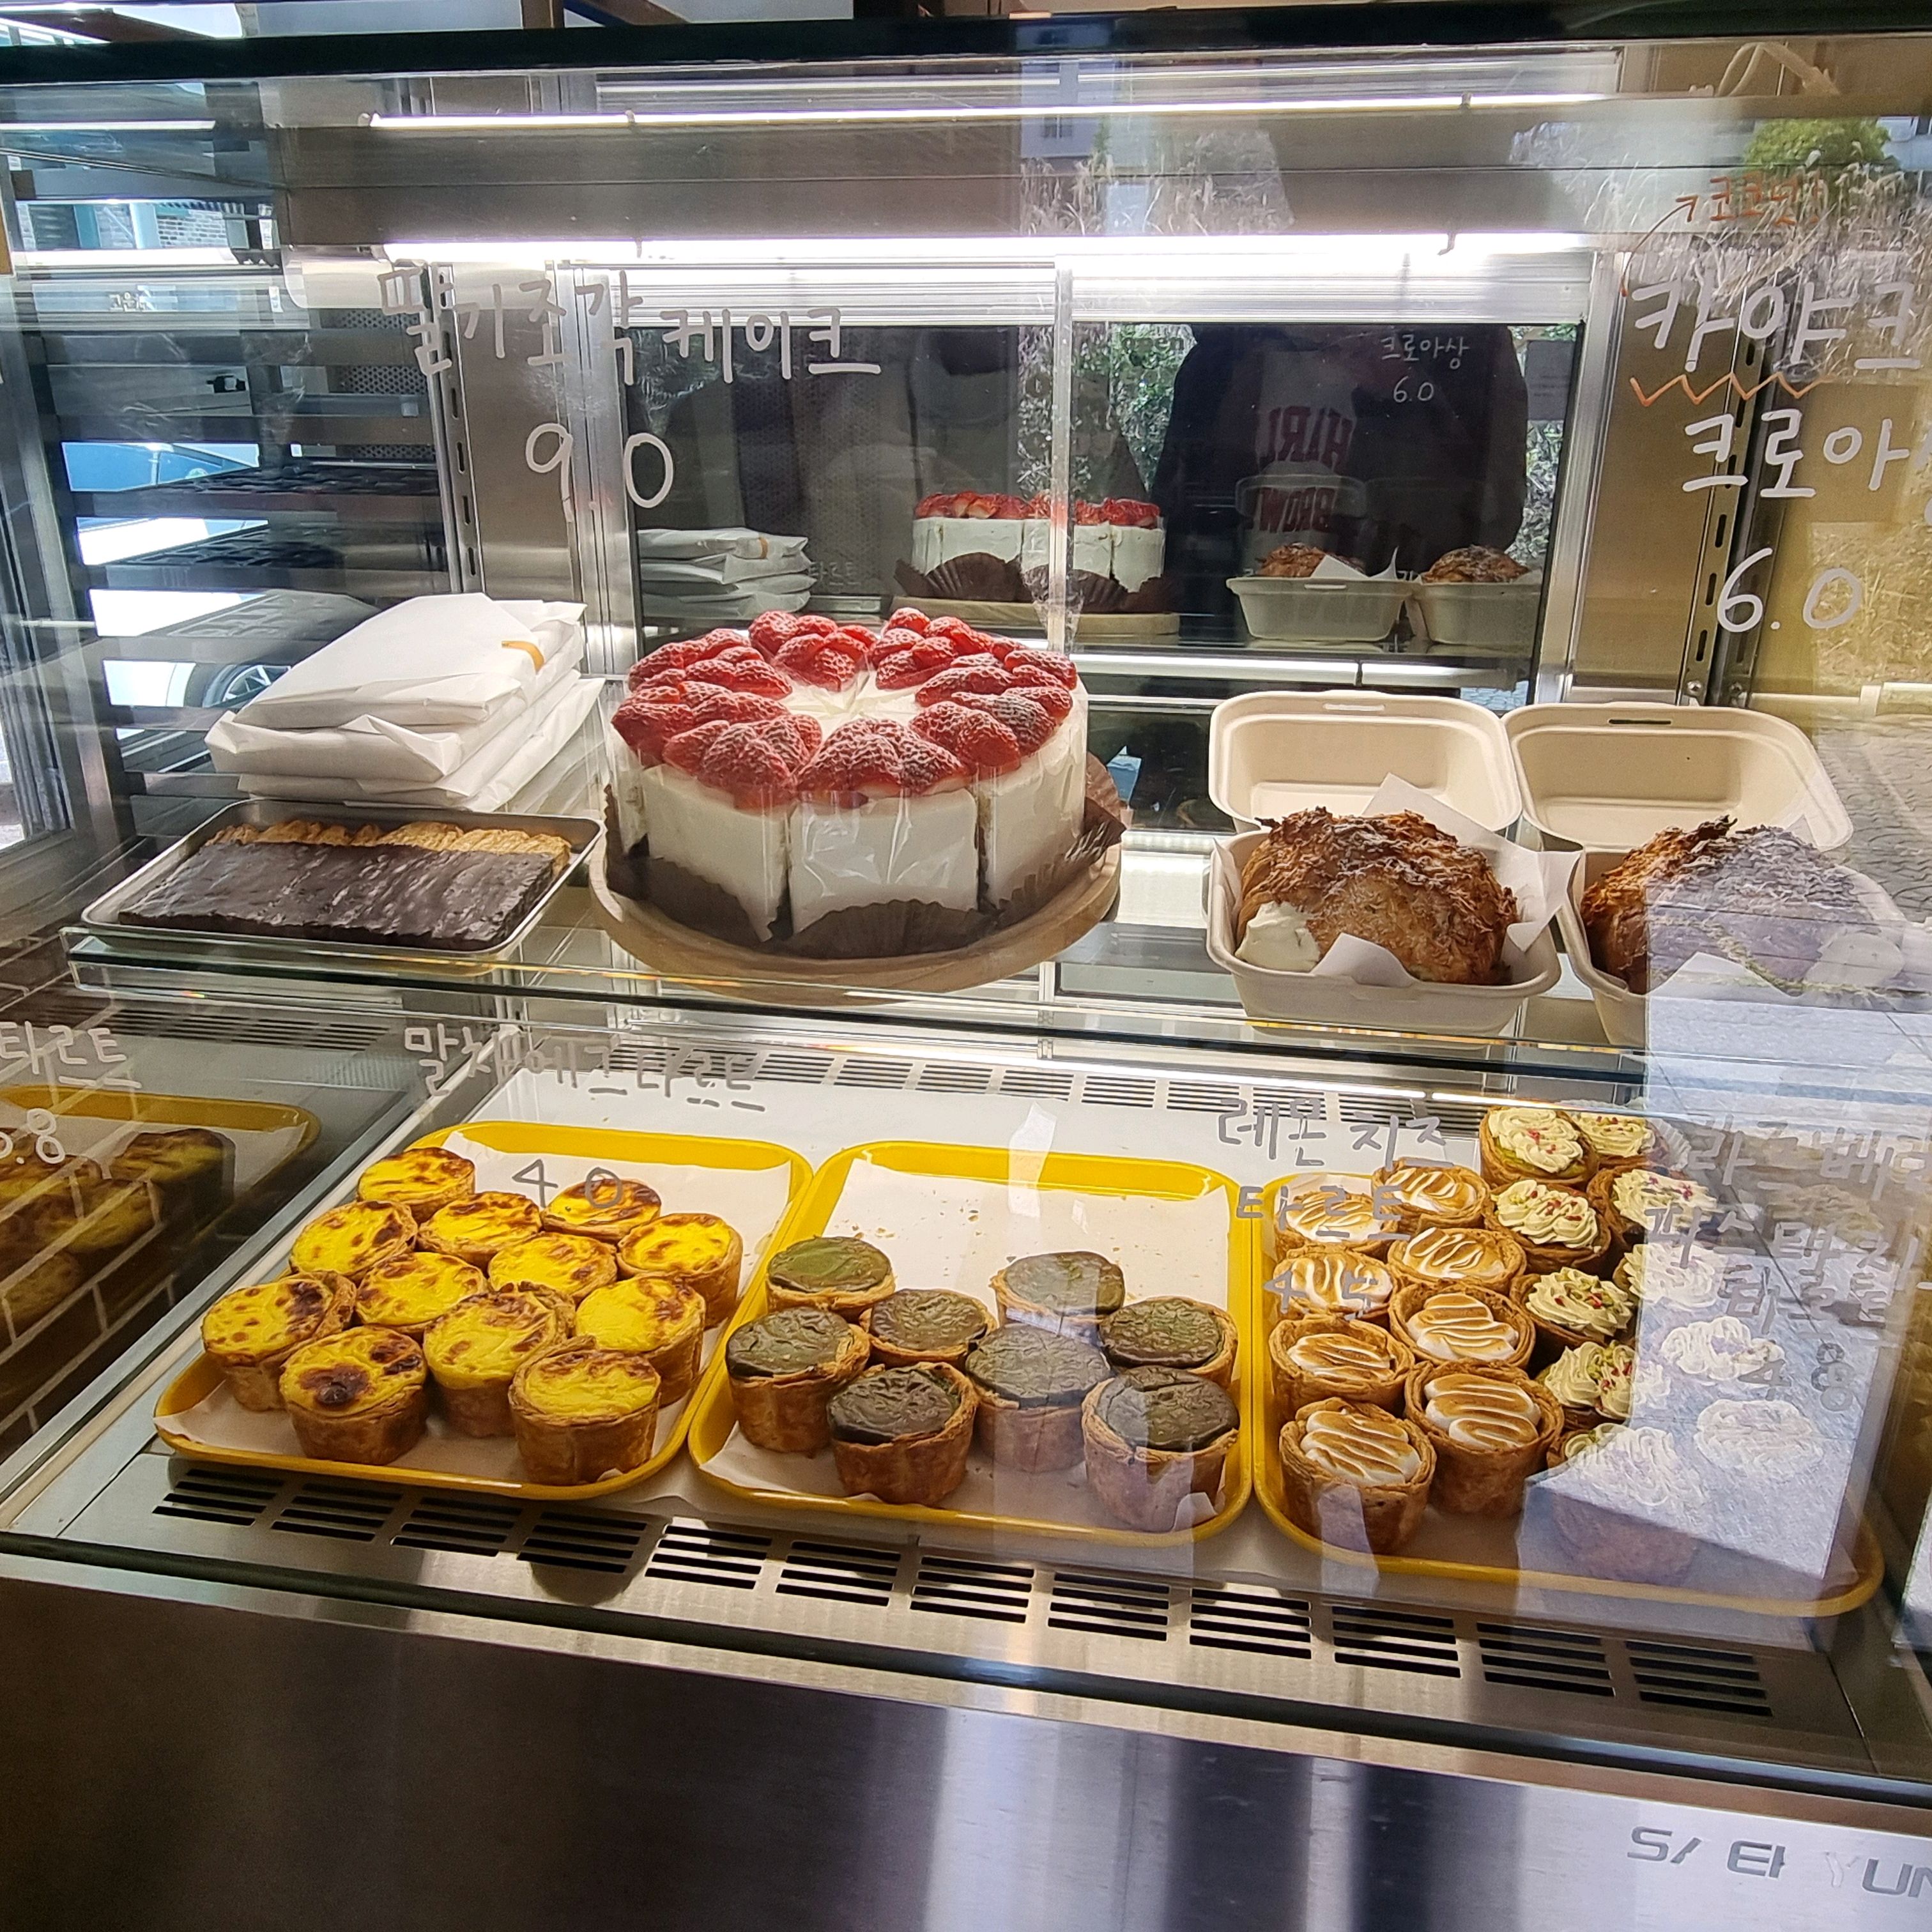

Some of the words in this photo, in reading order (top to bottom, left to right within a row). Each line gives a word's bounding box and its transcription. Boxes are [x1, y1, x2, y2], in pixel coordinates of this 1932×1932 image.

[1381, 334, 1470, 369] 크로아상
[1393, 376, 1434, 402] 6.0
[1717, 548, 1862, 633] 6.0
